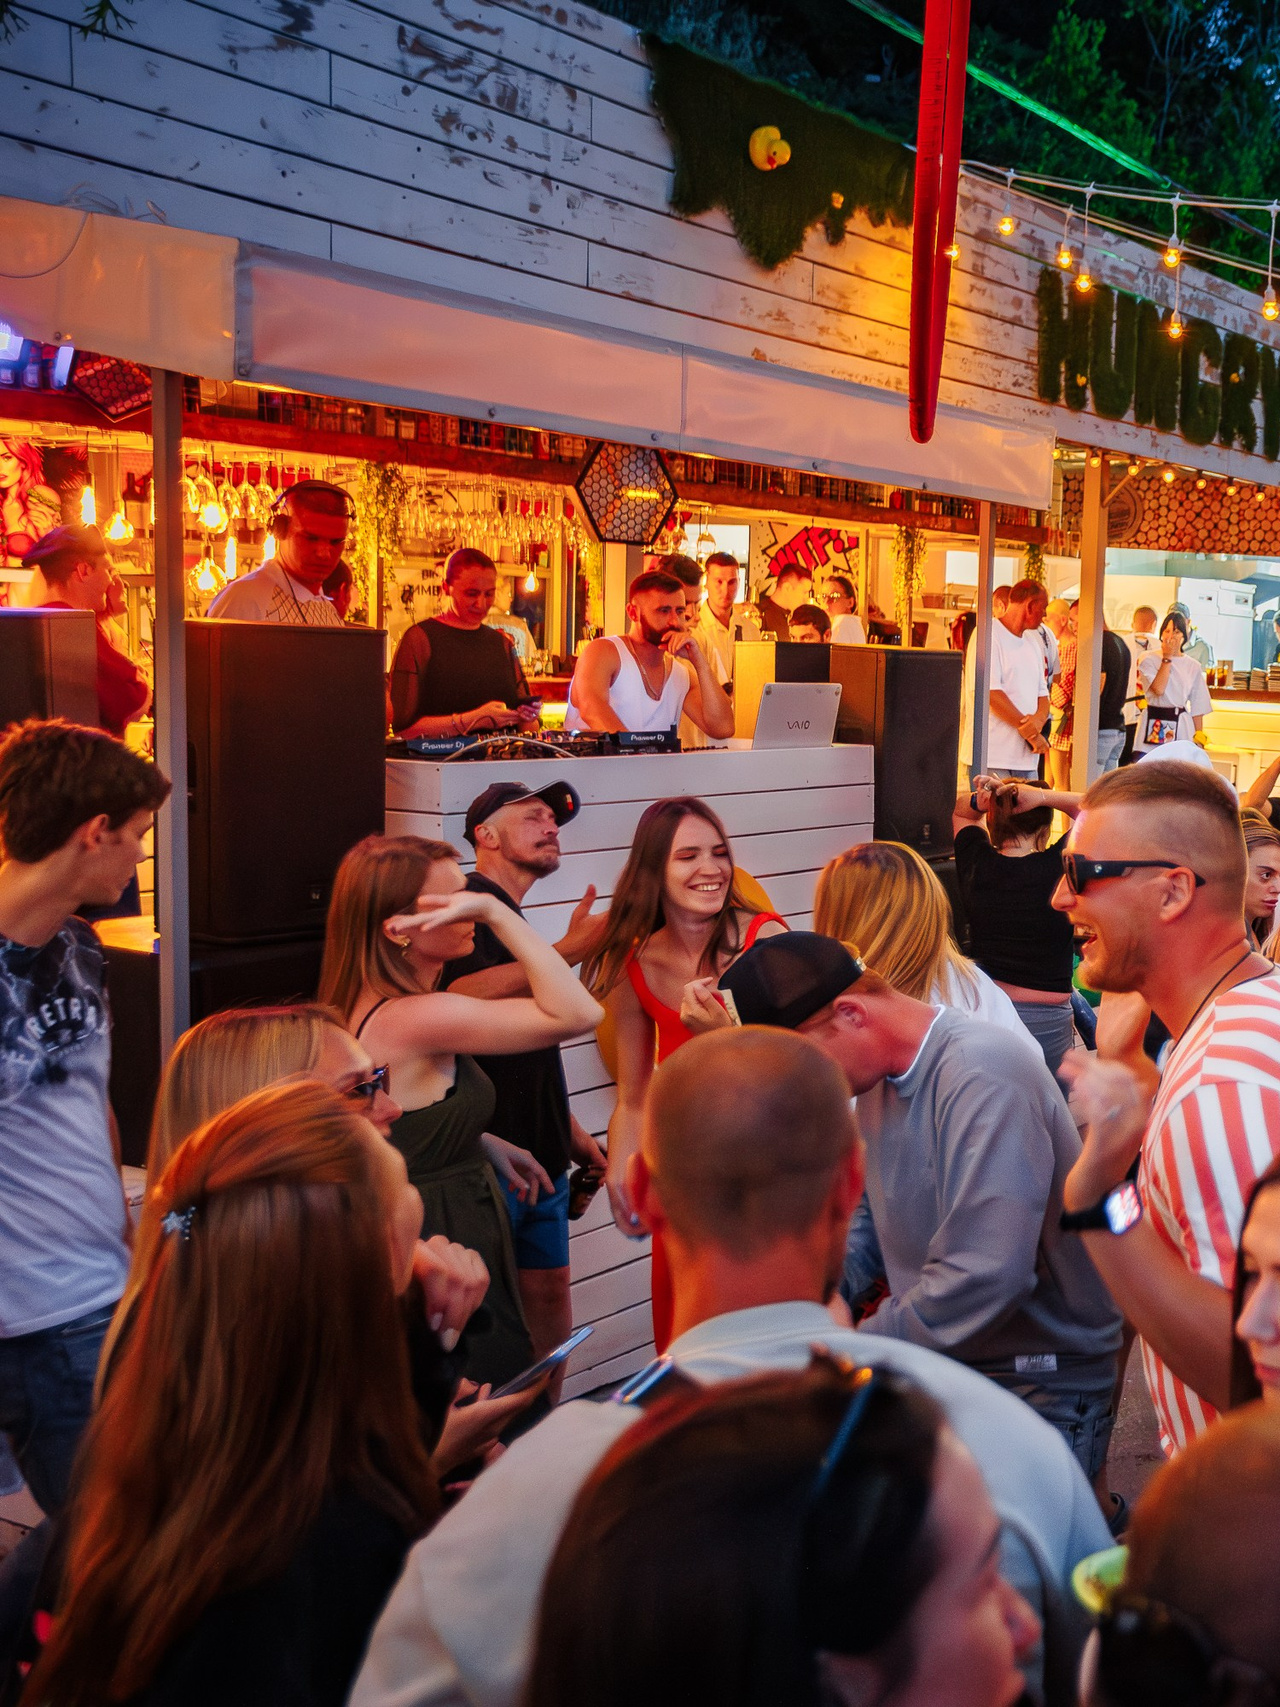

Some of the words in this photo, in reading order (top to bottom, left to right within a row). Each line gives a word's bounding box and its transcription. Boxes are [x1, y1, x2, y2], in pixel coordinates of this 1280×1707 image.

[787, 720, 811, 730] VAIO
[630, 733, 656, 741] Pioneer
[421, 742, 454, 750] Pioneer
